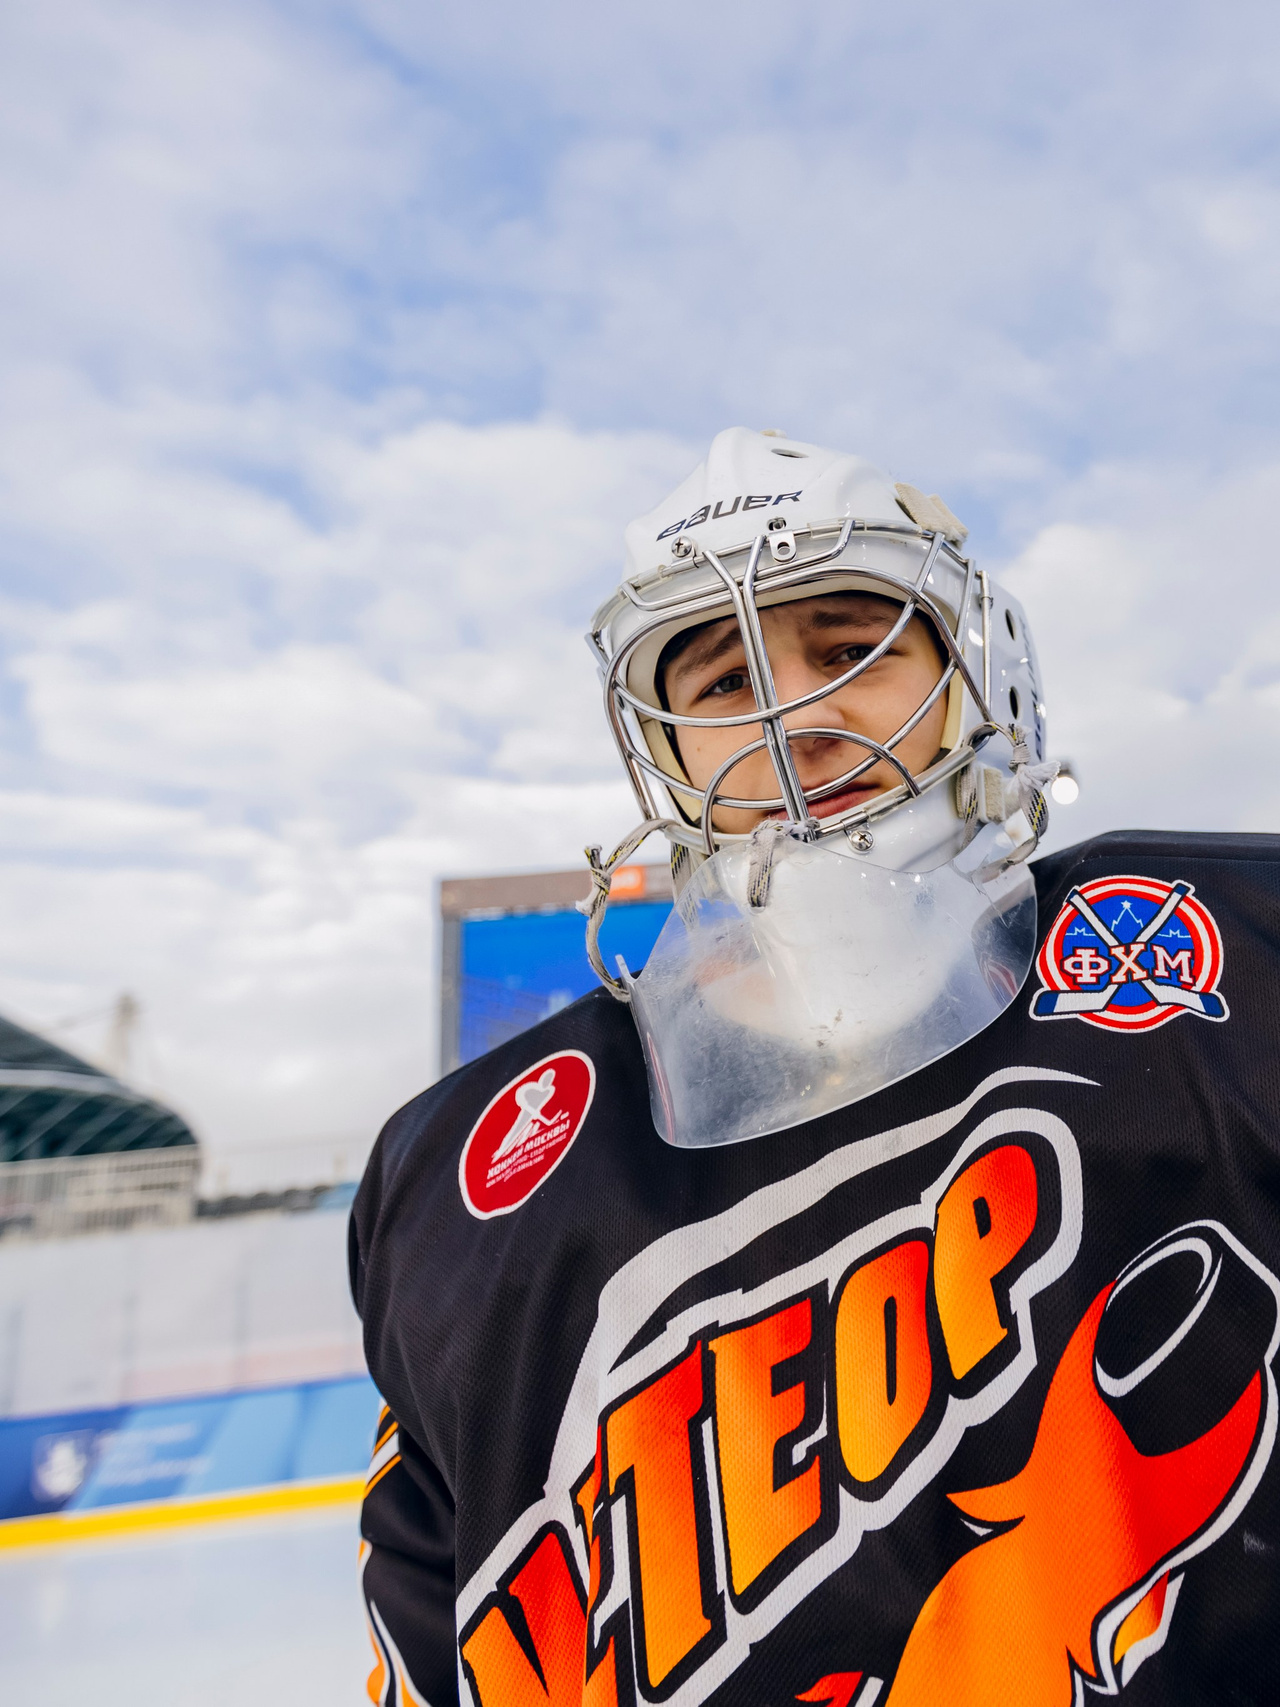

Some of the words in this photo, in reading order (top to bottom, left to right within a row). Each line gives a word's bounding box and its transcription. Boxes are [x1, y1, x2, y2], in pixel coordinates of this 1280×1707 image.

[656, 490, 803, 542] BAUER
[1061, 941, 1197, 985] ФХМ
[523, 1119, 570, 1153] МОСКВЫ
